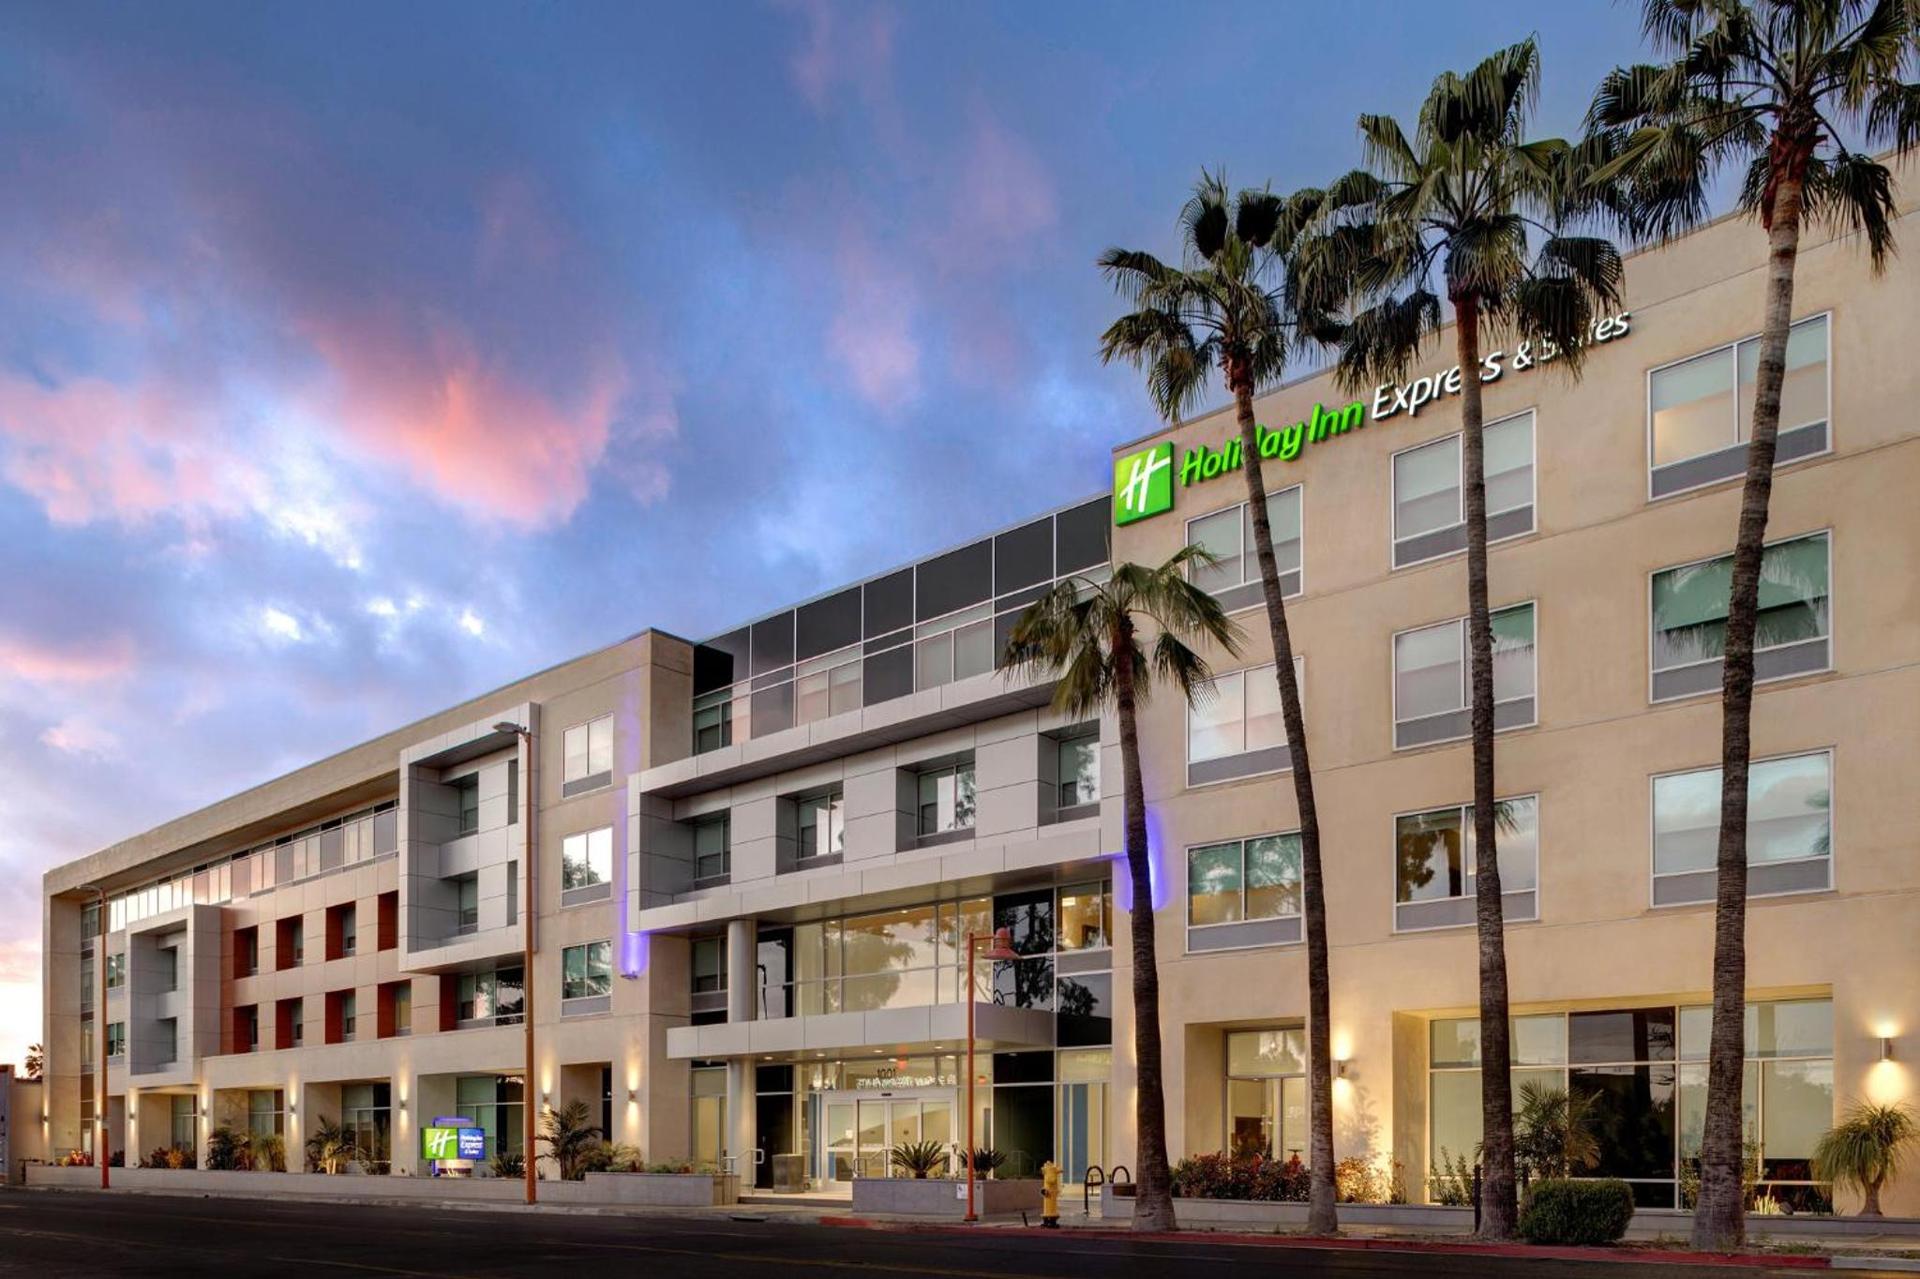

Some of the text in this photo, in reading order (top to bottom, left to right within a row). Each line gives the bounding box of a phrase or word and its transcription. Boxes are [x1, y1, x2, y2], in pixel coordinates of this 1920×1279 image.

[1179, 311, 1632, 487] Holiay Inn Expres & Stes
